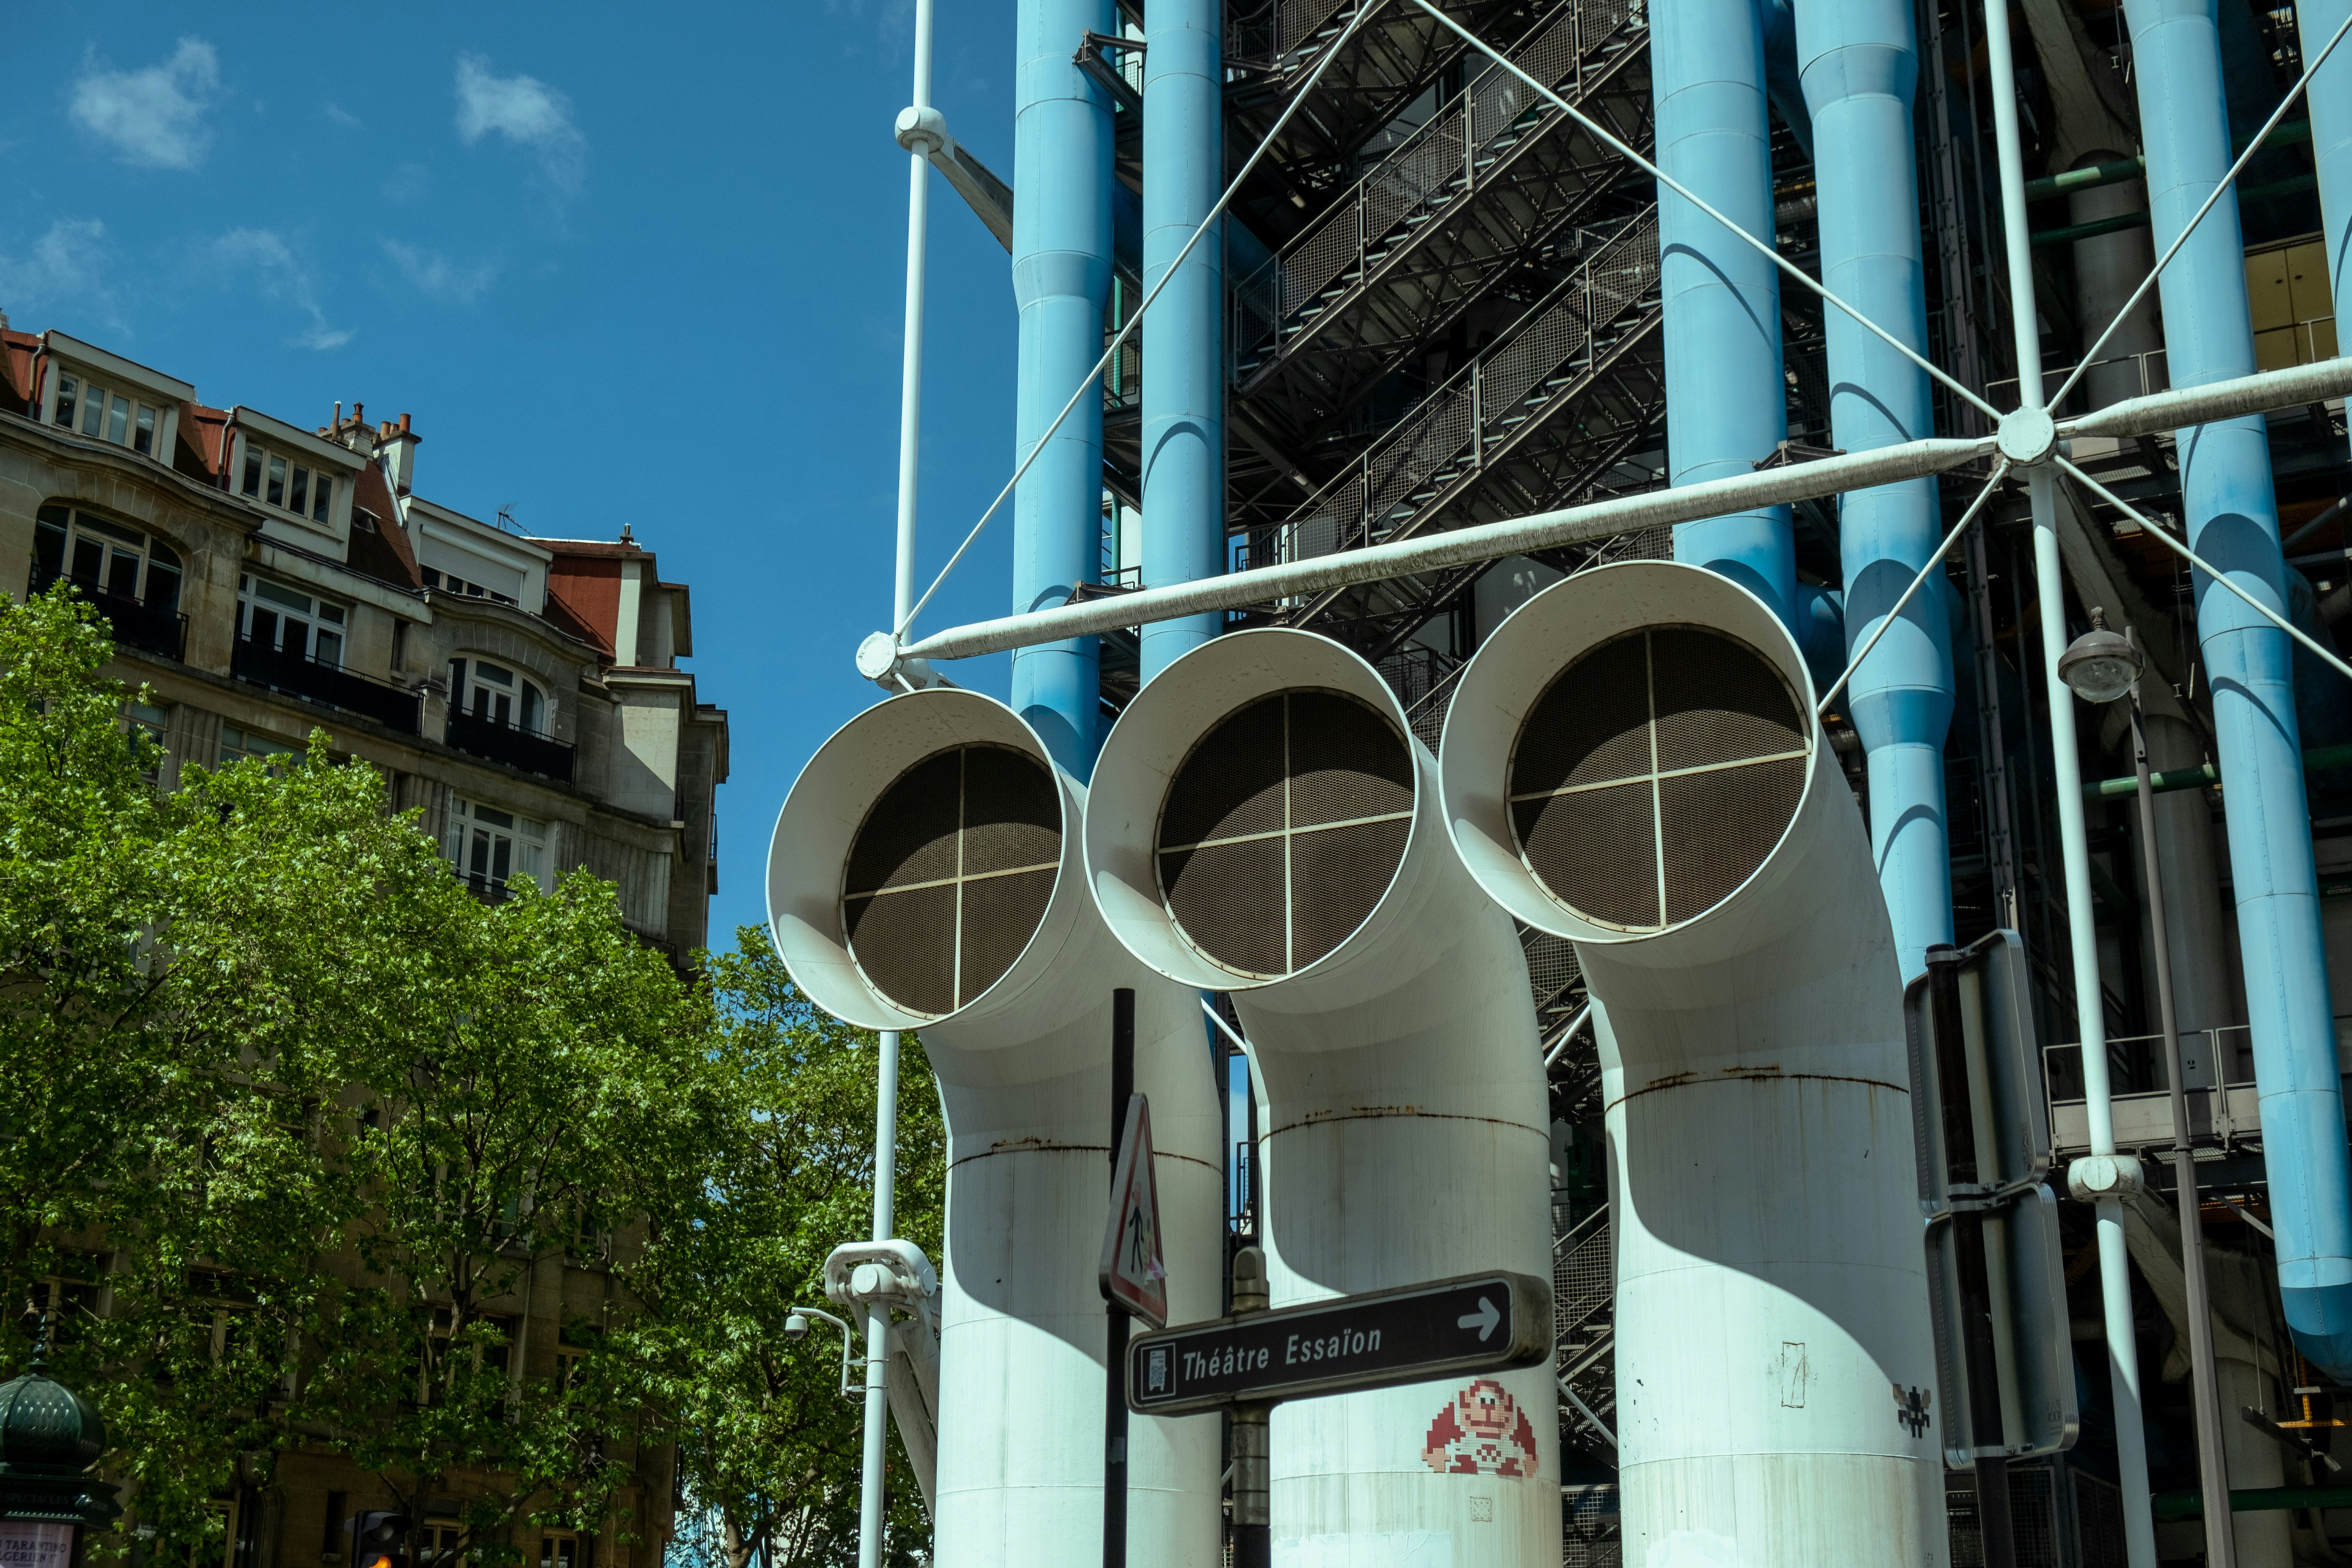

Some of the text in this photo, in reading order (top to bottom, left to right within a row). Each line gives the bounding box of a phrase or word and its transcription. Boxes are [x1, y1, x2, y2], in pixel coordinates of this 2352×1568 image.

[1183, 1328, 1381, 1381] Théâtre Essaïon
[6, 1493, 69, 1504] SPECTACLES
